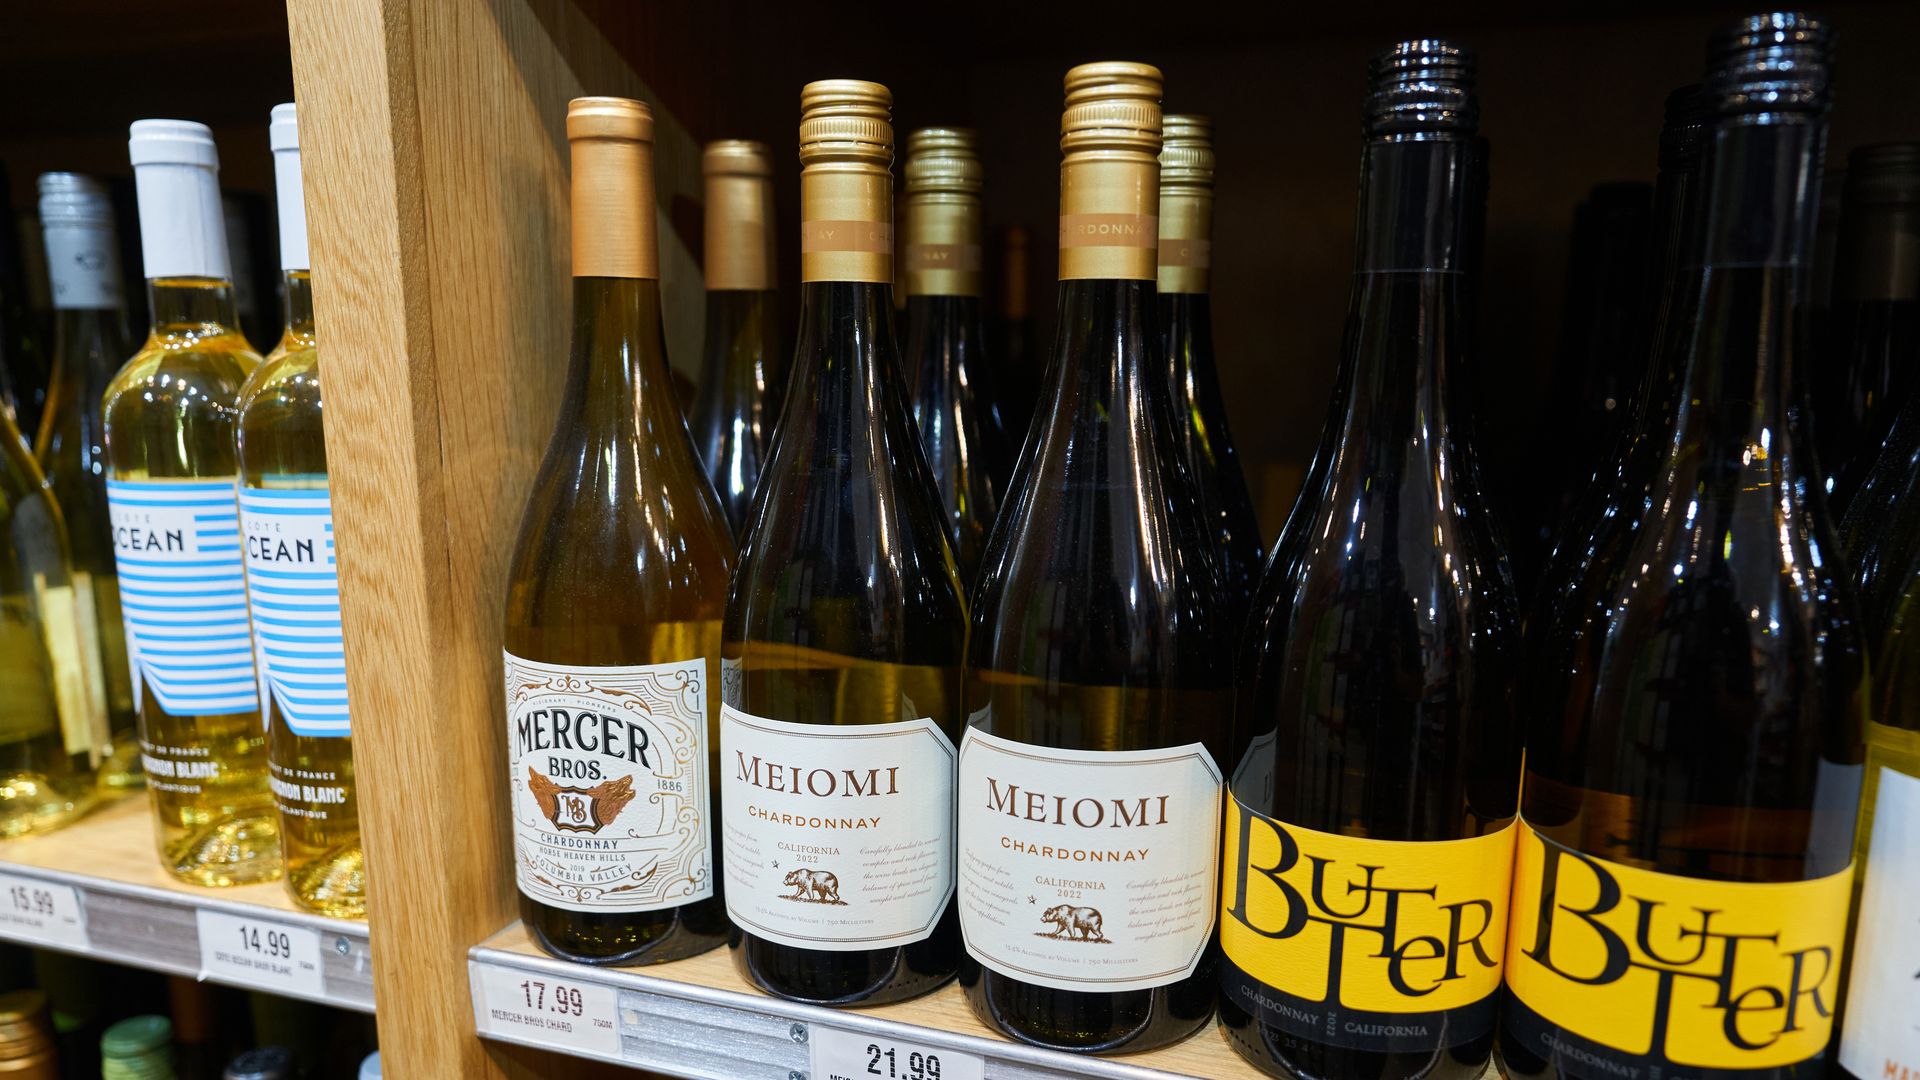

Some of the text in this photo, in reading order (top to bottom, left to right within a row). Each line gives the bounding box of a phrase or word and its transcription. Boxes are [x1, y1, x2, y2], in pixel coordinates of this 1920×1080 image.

[113, 527, 183, 551] CEAN
[246, 535, 314, 562] CEAN
[577, 699, 616, 713] PIONEERS
[517, 708, 653, 770] MERCER
[176, 761, 219, 779] BLANC
[296, 770, 336, 781] FRANCE
[548, 755, 608, 780] BROS.
[736, 749, 899, 798] MEIOMI
[302, 785, 346, 804] BLANC
[656, 779, 683, 792] 1886
[986, 776, 1169, 829] MEIOMI
[748, 805, 881, 829] CHARDONNAY
[540, 833, 618, 850] CHARDONNAY
[777, 841, 841, 856] CALIFORNIA
[1001, 836, 1149, 862] CHARDONNAY
[540, 846, 626, 862] HORSE HEAVEN HILLS
[796, 854, 819, 864] 2022
[535, 854, 633, 883] COLUMBIA VALLEY
[570, 863, 586, 872] 2019
[1035, 875, 1106, 890] CALIFORNIA
[1056, 889, 1082, 899] 2022
[10, 885, 55, 916] 15.99
[239, 924, 291, 959] 14.99
[520, 979, 584, 1017] 17.99
[1240, 984, 1319, 1025] CHARDONNAY
[491, 1008, 613, 1033] MERCER BROS CHARD 750M
[1326, 1011, 1337, 1037] 2022
[1344, 1021, 1428, 1037] CALIFORNIA
[866, 1043, 941, 1080] 21.99
[1540, 1031, 1641, 1079] CHARDONNAY
